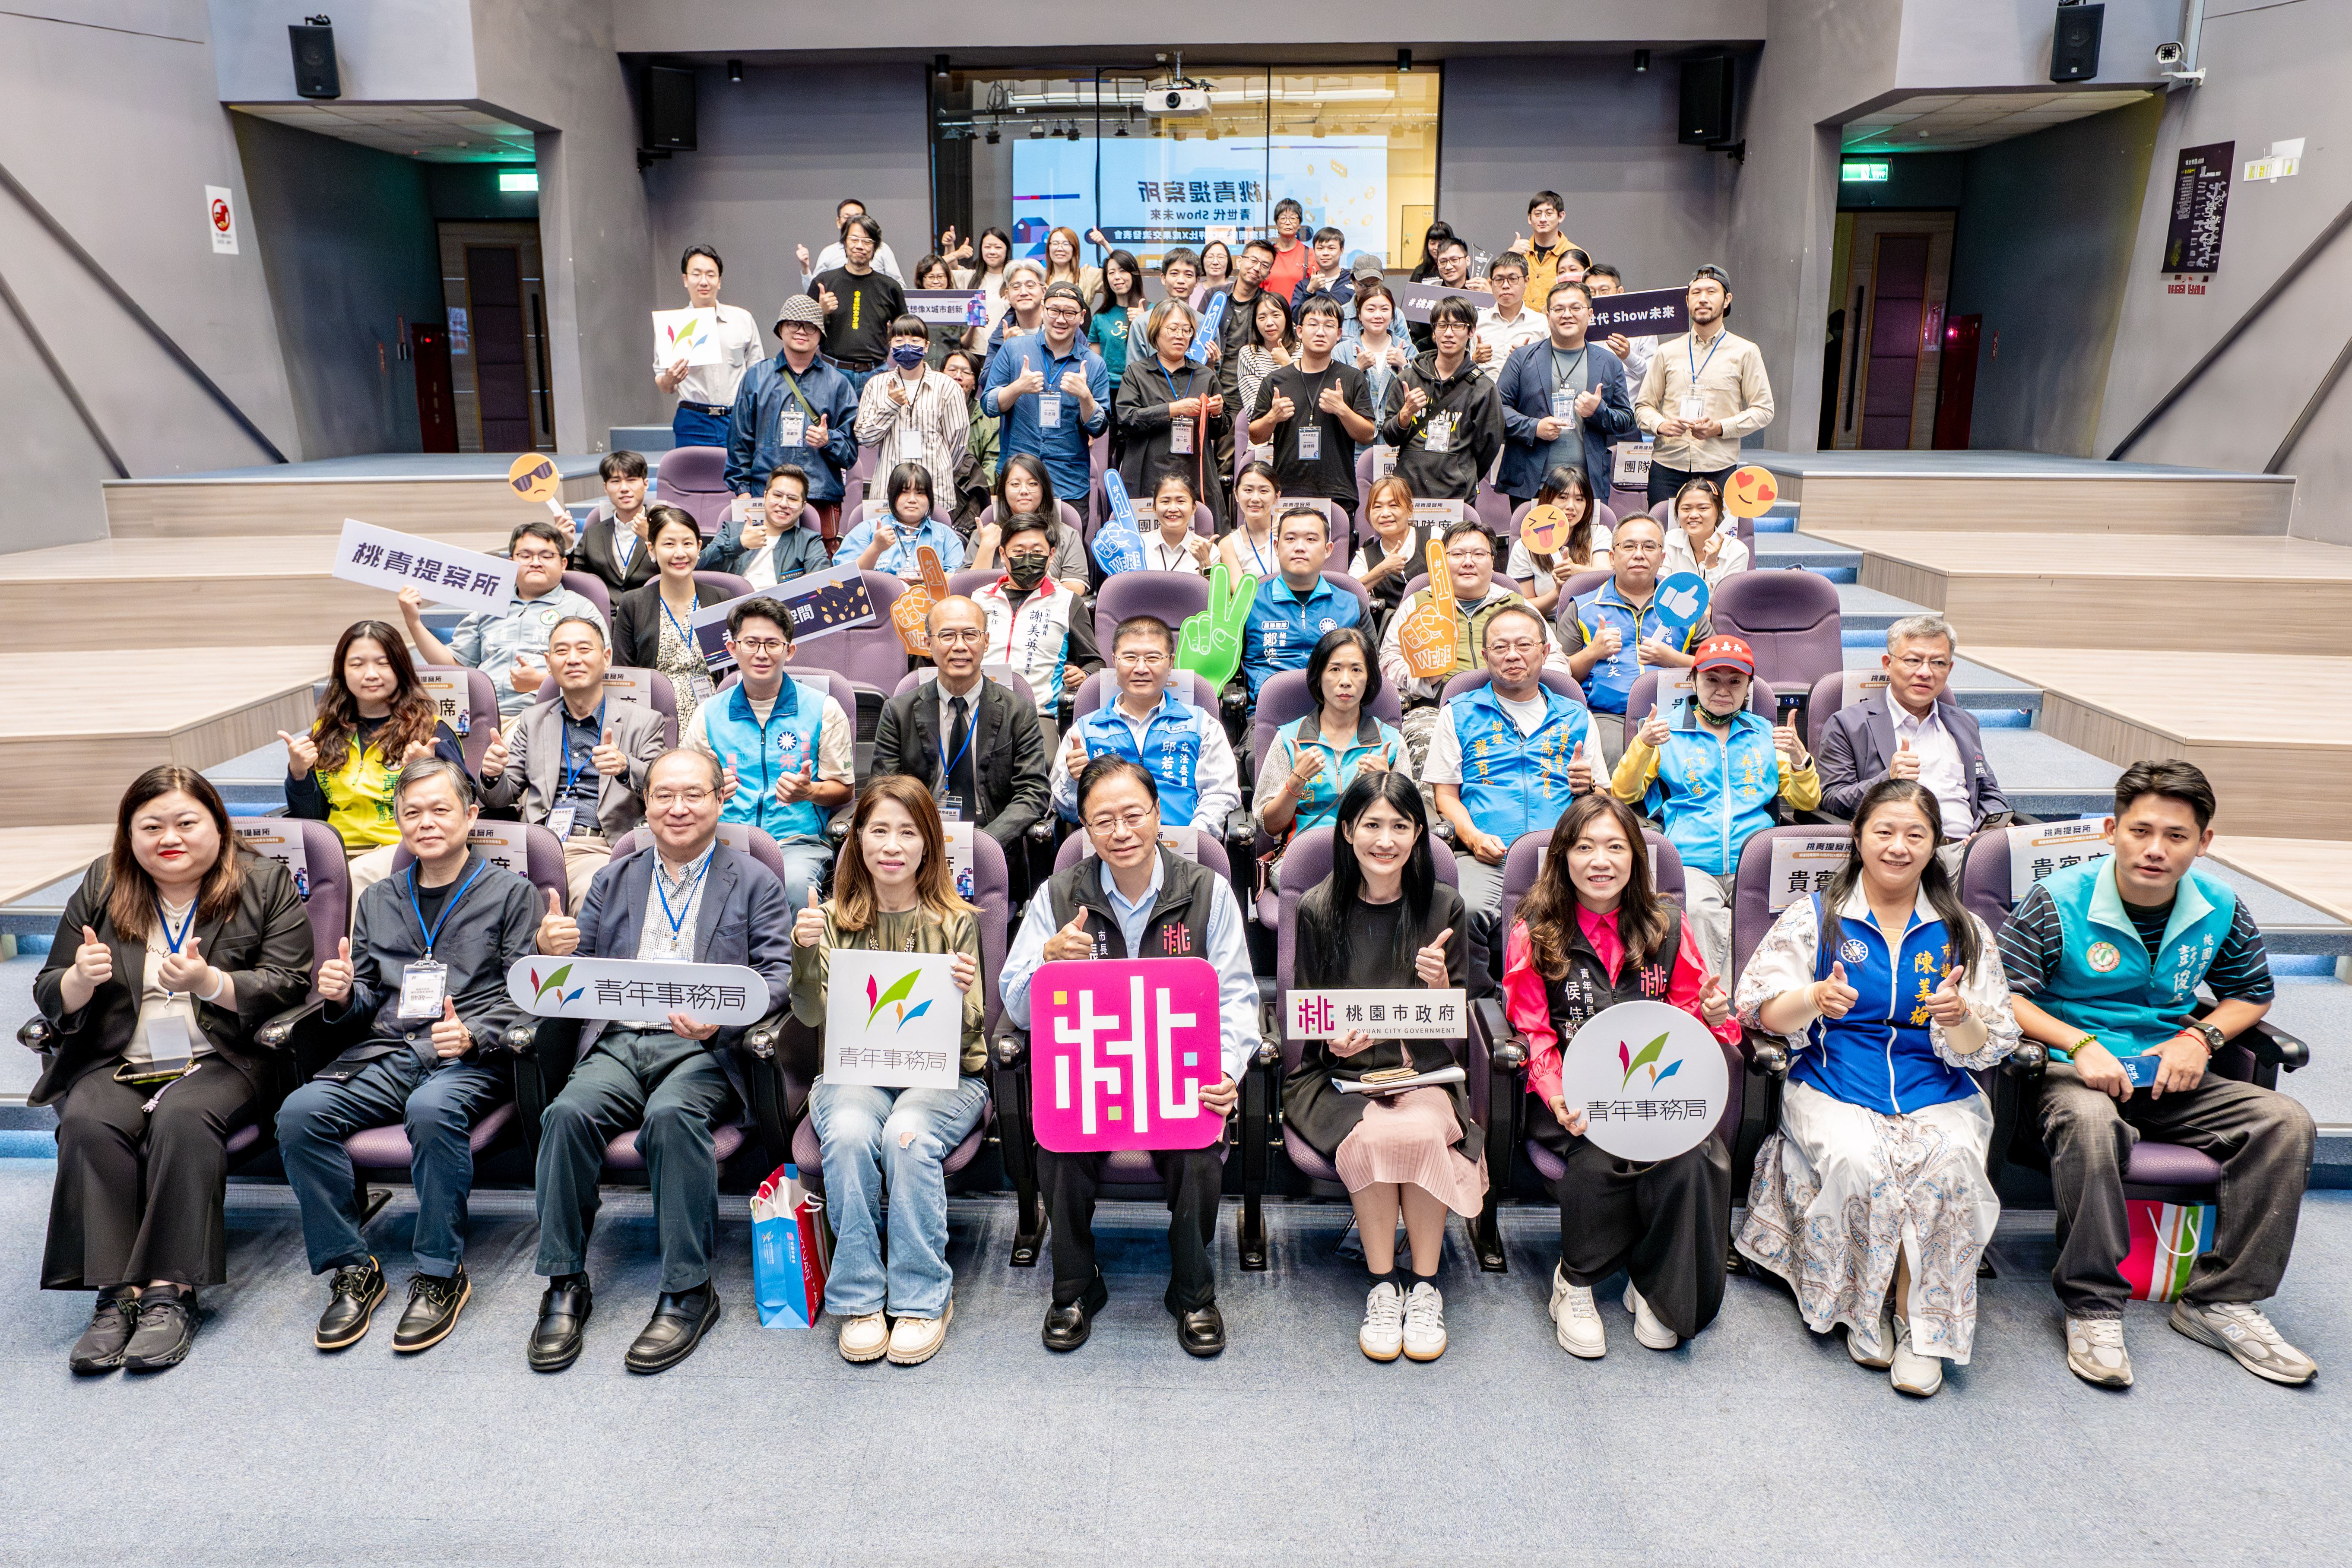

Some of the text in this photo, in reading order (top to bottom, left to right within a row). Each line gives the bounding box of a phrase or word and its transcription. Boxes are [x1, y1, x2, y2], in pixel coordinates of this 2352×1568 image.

[907, 305, 963, 314] 想像X城市創新
[1624, 460, 1650, 473] 團隊
[1113, 485, 1130, 518] #1
[352, 542, 501, 596] 桃青提案所
[1434, 558, 1450, 600] #1
[1025, 610, 1043, 652] 謝美英
[440, 698, 456, 717] 席
[1492, 720, 1503, 744] 助理
[1179, 741, 1194, 787] 立法委員
[1741, 754, 1756, 799] 吳嘉和
[2044, 824, 2091, 836] 桃青提案所
[1098, 930, 1108, 956] 市長
[594, 978, 745, 1011] 青年事務局
[1580, 968, 1595, 1016] 青年局長
[1909, 950, 1938, 1026] 陳美梅
[1346, 1004, 1455, 1023] 桃園市政府
[838, 1047, 946, 1071] 青年事務局
[1586, 1098, 1706, 1122] 青年事務局
